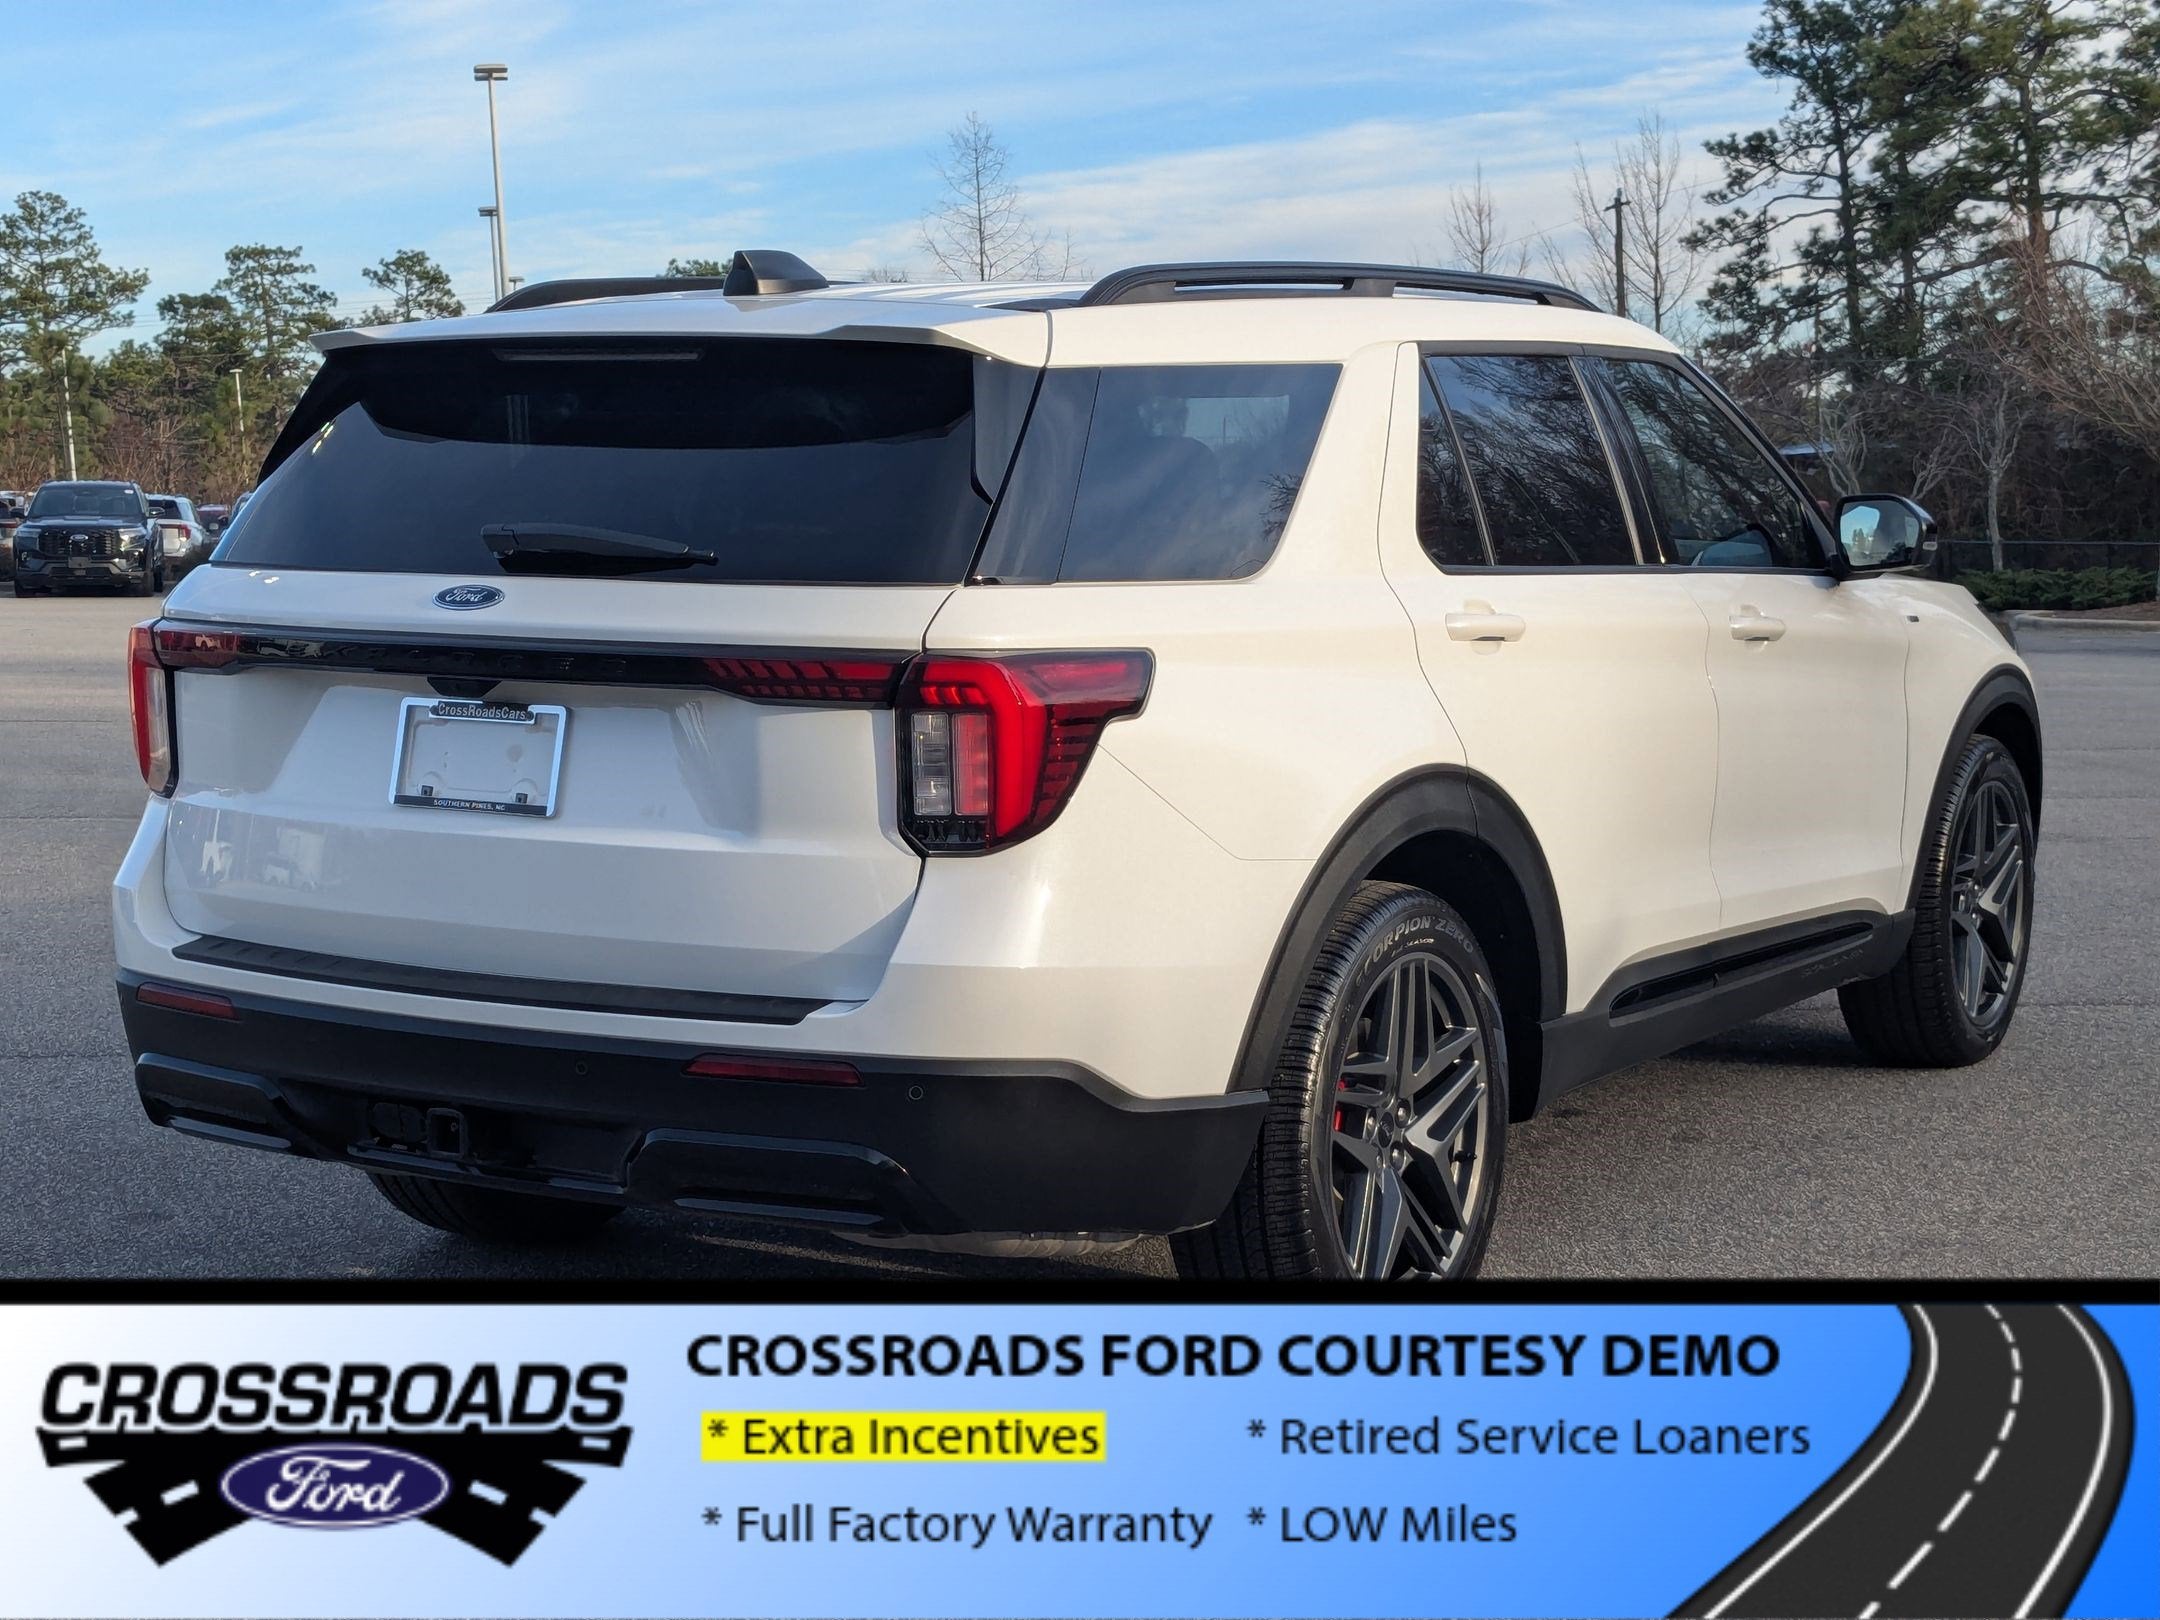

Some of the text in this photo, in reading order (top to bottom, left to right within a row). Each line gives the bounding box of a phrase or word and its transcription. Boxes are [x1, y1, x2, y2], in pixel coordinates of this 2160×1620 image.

[444, 587, 488, 602] Ford
[438, 702, 527, 721] CrossRoadsCars
[433, 798, 471, 808] SOUTHERN
[1435, 917, 1474, 953] ZERO
